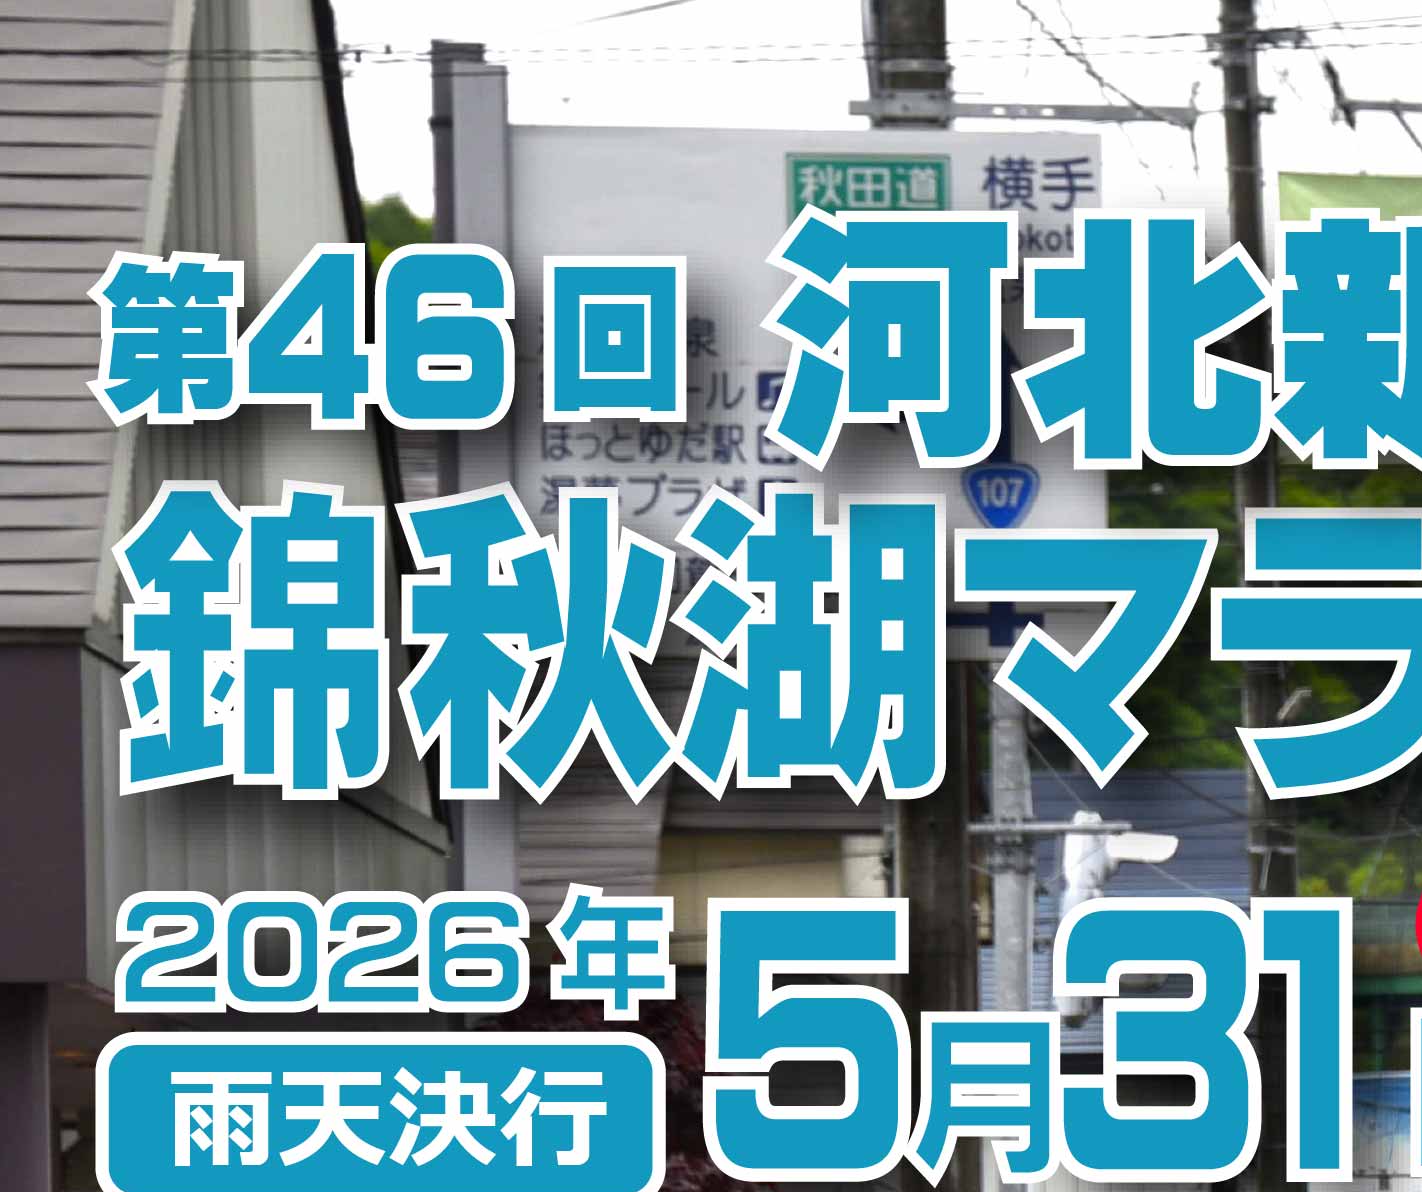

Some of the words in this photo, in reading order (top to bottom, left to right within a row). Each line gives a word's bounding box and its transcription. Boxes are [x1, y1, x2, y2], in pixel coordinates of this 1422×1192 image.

[796, 164, 939, 208] 秋田道
[981, 155, 1095, 212] 横手
[540, 423, 747, 464] ほっとゆだ駅
[976, 476, 1025, 508] 107
